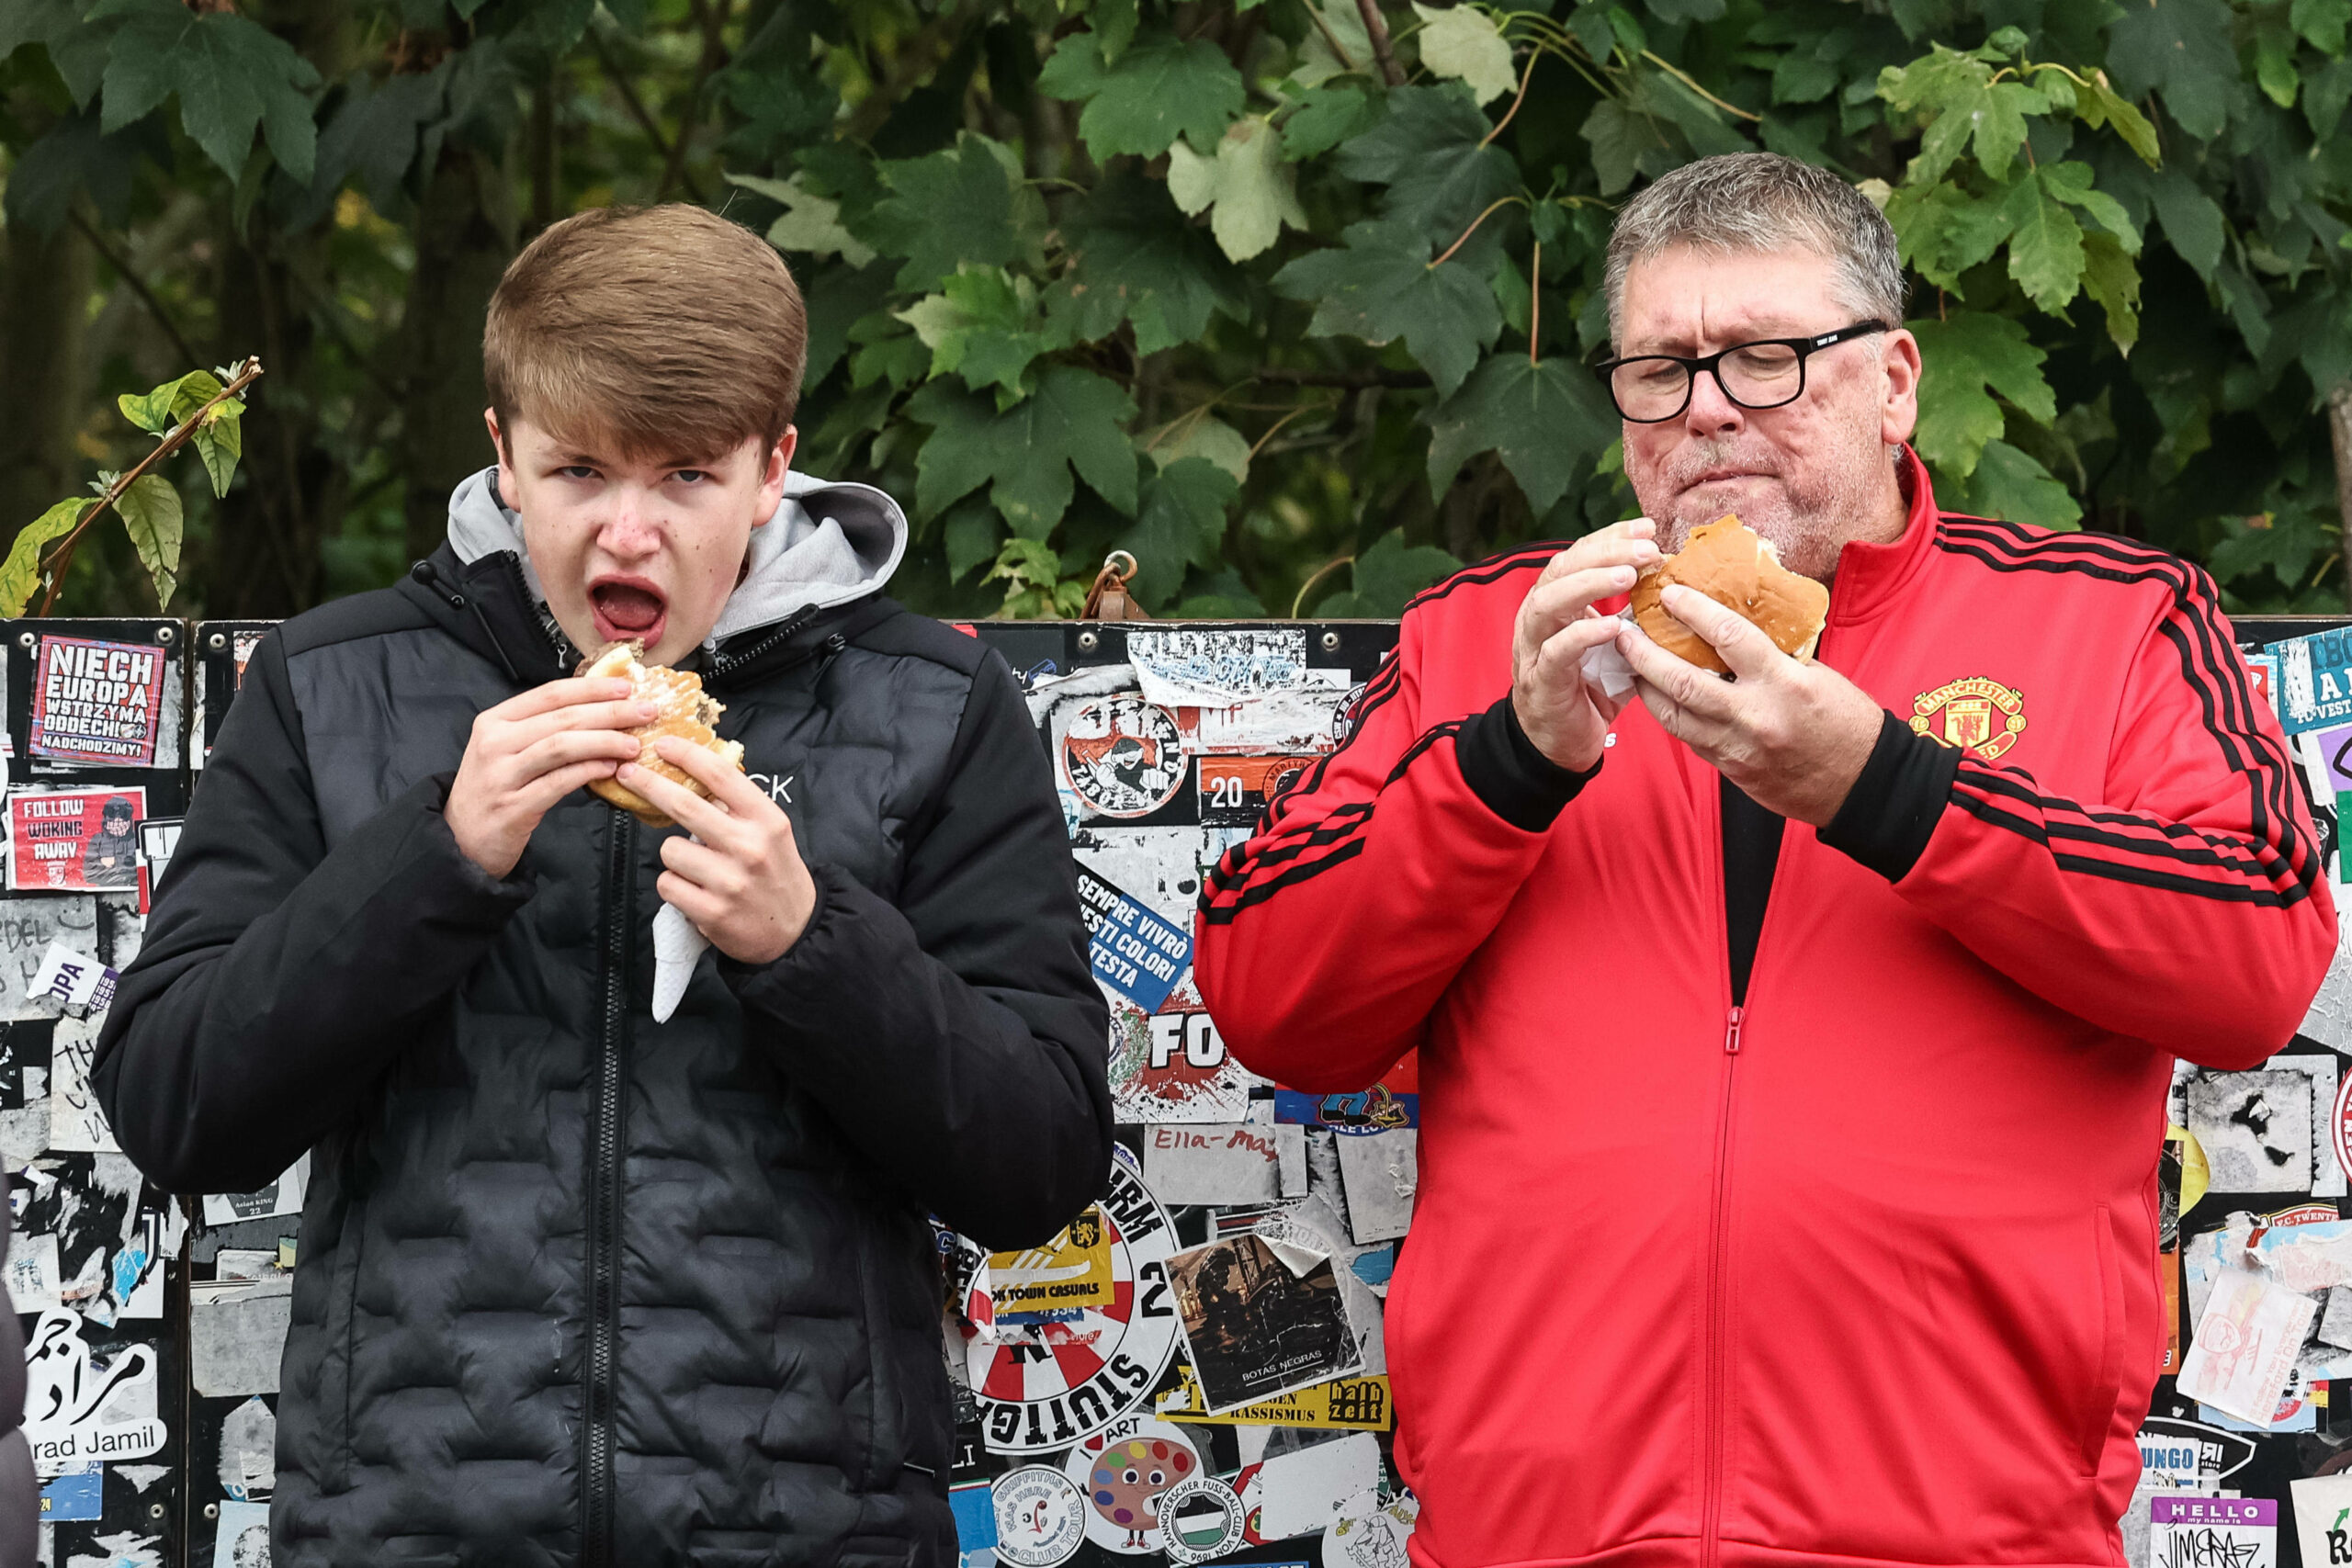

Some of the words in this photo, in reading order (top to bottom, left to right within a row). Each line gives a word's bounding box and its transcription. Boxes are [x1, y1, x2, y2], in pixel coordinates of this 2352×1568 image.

[49, 644, 153, 685] NIECH
[46, 674, 148, 708] EUROPA
[1923, 682, 2016, 711] MANCHESTER
[46, 698, 146, 724] WSTRZYMA
[44, 714, 120, 738] ODDECH!
[41, 735, 141, 757] NADCHODZIMY!
[1211, 776, 1243, 807] 20
[23, 799, 84, 818] FOLLOW
[28, 821, 83, 838] WOKING
[35, 842, 77, 860] AWAY
[1078, 874, 1139, 928] SEMPRE
[1137, 916, 1187, 959] VIVRÒ
[1080, 902, 1119, 943] ESTI
[1116, 933, 1176, 983] COLORI
[1091, 942, 1137, 988] TESTA
[249, 1207, 262, 1215] 22
[255, 1198, 273, 1206] KING
[1008, 1287, 1046, 1301] TOWN
[1049, 1284, 1099, 1297] CASUALS
[1242, 1364, 1277, 1382] BOTAS
[1280, 1349, 1323, 1369] NEGRAS
[2258, 1359, 2290, 1421] Hereford
[2284, 1339, 2300, 1359] On
[2296, 1304, 2313, 1338] Tour
[1331, 1382, 1380, 1402] halb
[1331, 1403, 1379, 1420] zeit
[85, 1425, 154, 1455] Jamil
[1106, 1417, 1140, 1442] ART
[996, 1472, 1064, 1502] GRIFFITHS
[1015, 1486, 1052, 1502] HERE
[1161, 1481, 1199, 1549] HANNOVERSCHER
[1204, 1481, 1241, 1537] FUSS-BALL-CLUB
[2171, 1504, 2259, 1518] HELLO
[1018, 1544, 1063, 1565] CLUB
[1060, 1499, 1083, 1545] TOUR
[1191, 1553, 1211, 1562] 1896
[1216, 1540, 1235, 1557] VON
